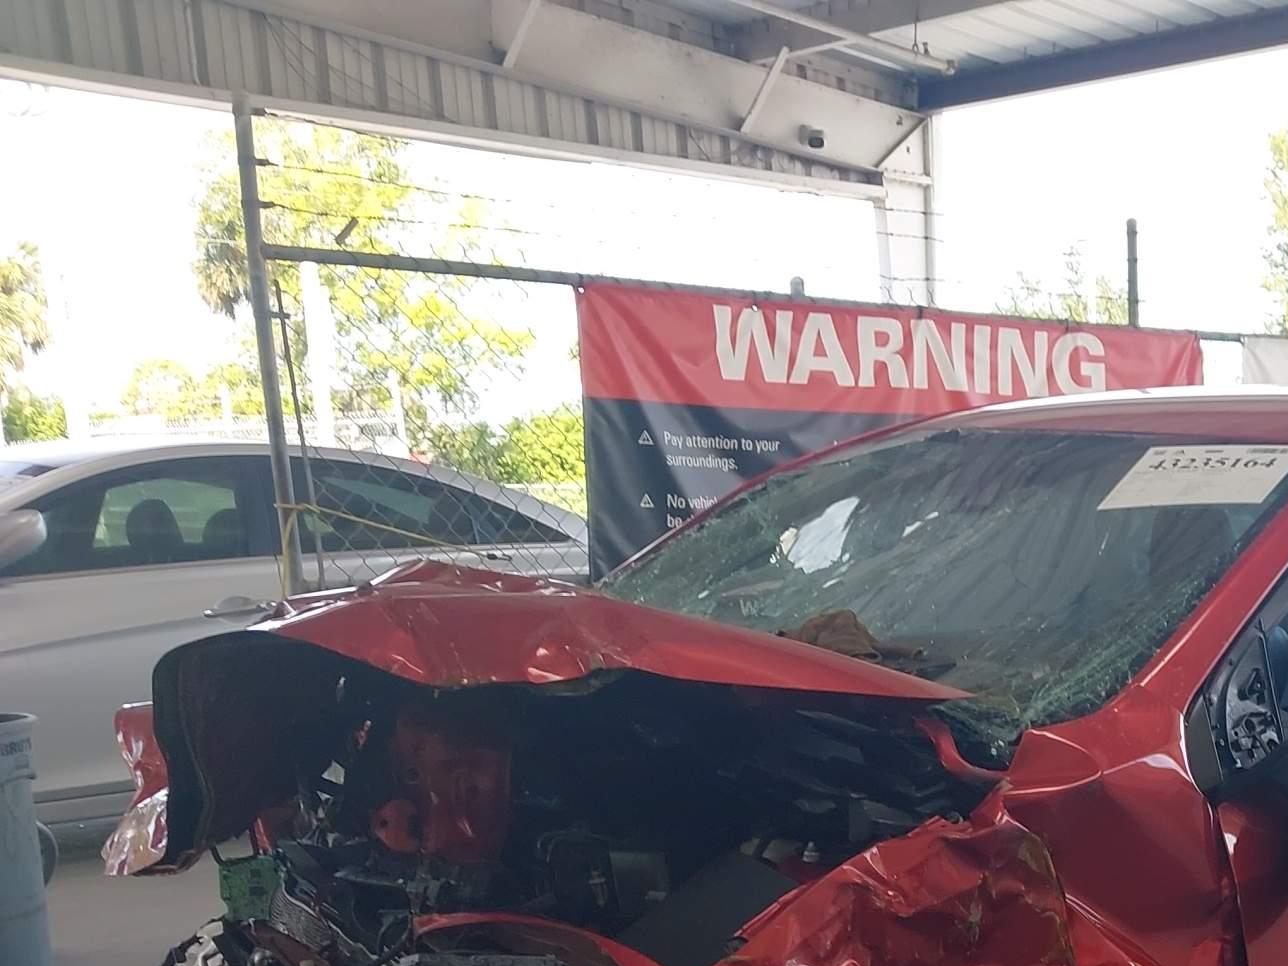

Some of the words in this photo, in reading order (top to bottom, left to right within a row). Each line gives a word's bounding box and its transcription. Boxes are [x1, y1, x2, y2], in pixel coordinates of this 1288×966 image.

[713, 304, 1107, 398] WARNING
[663, 431, 684, 450] Pay
[686, 435, 738, 450] attention
[741, 438, 753, 451] to
[755, 439, 780, 454] your
[666, 454, 738, 472] surroundings.
[667, 494, 686, 509] No
